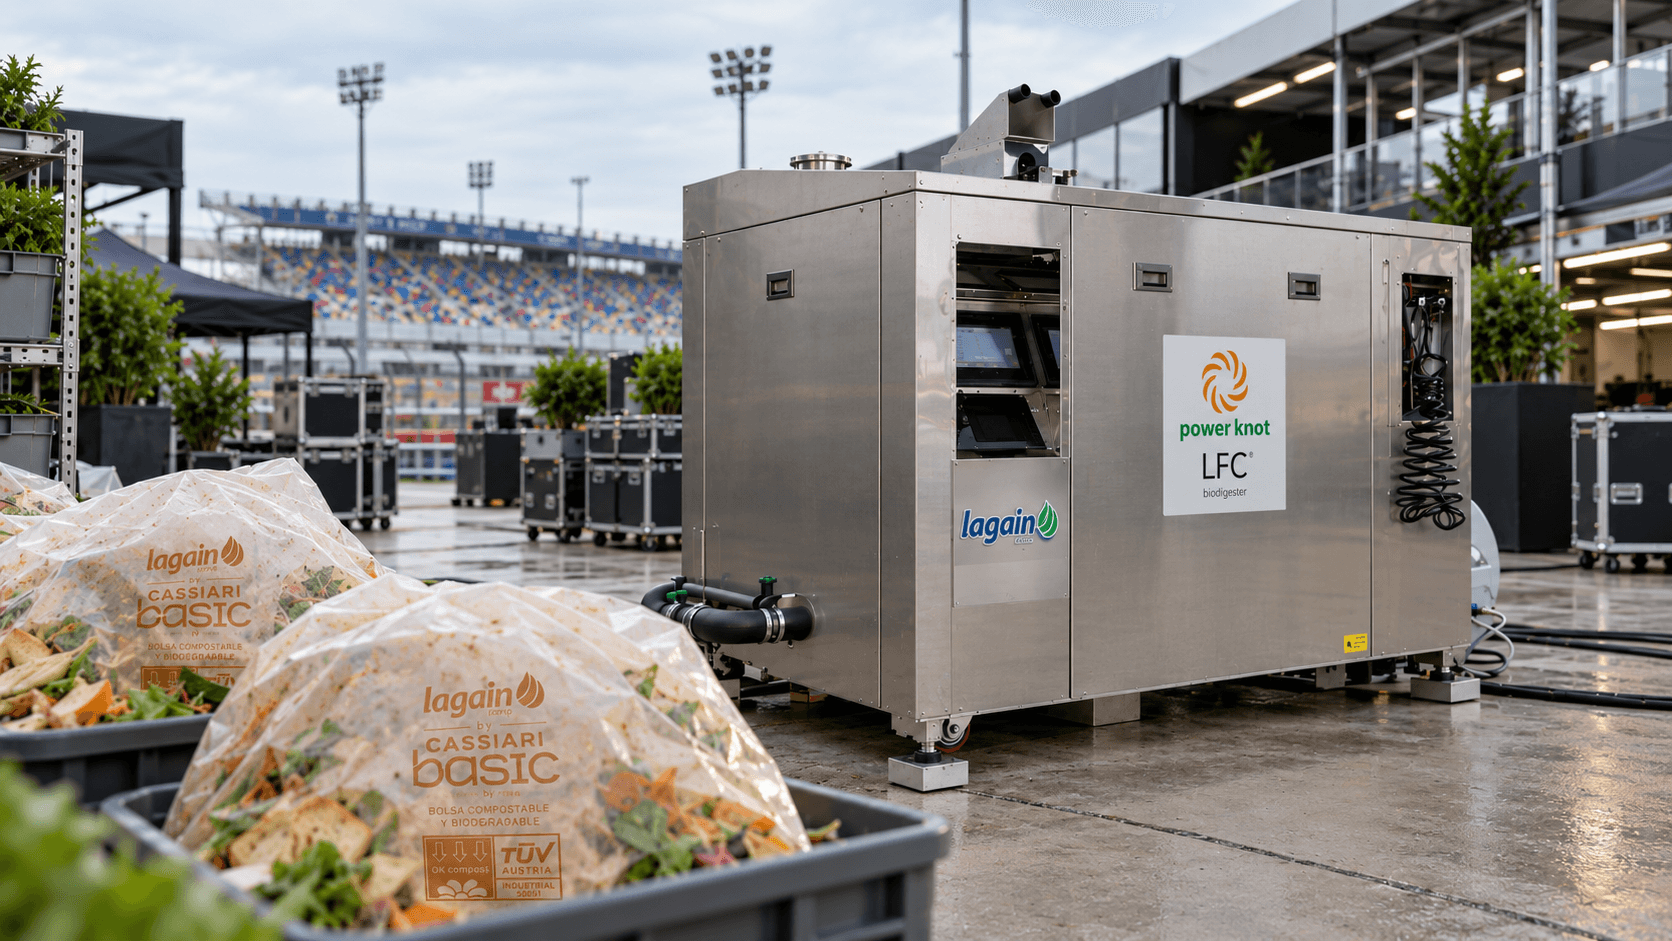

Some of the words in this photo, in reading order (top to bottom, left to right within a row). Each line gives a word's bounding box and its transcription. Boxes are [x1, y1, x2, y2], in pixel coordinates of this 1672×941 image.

[1180, 423, 1231, 441] power
[1234, 418, 1271, 436] knot
[1203, 487, 1247, 499] biodigester
[961, 507, 1036, 545] lagain
[146, 543, 218, 575] lagain
[148, 585, 241, 602] CASSIARI
[423, 681, 513, 718] lagain
[477, 721, 492, 732] by
[425, 731, 544, 753] CASSIARI
[428, 806, 464, 815] BOLSA
[468, 804, 549, 814] COMPOSTABLE
[441, 819, 447, 827] Y
[501, 842, 556, 864] TÜV
[432, 866, 445, 874] OK
[502, 866, 552, 875] AUSTRIA
